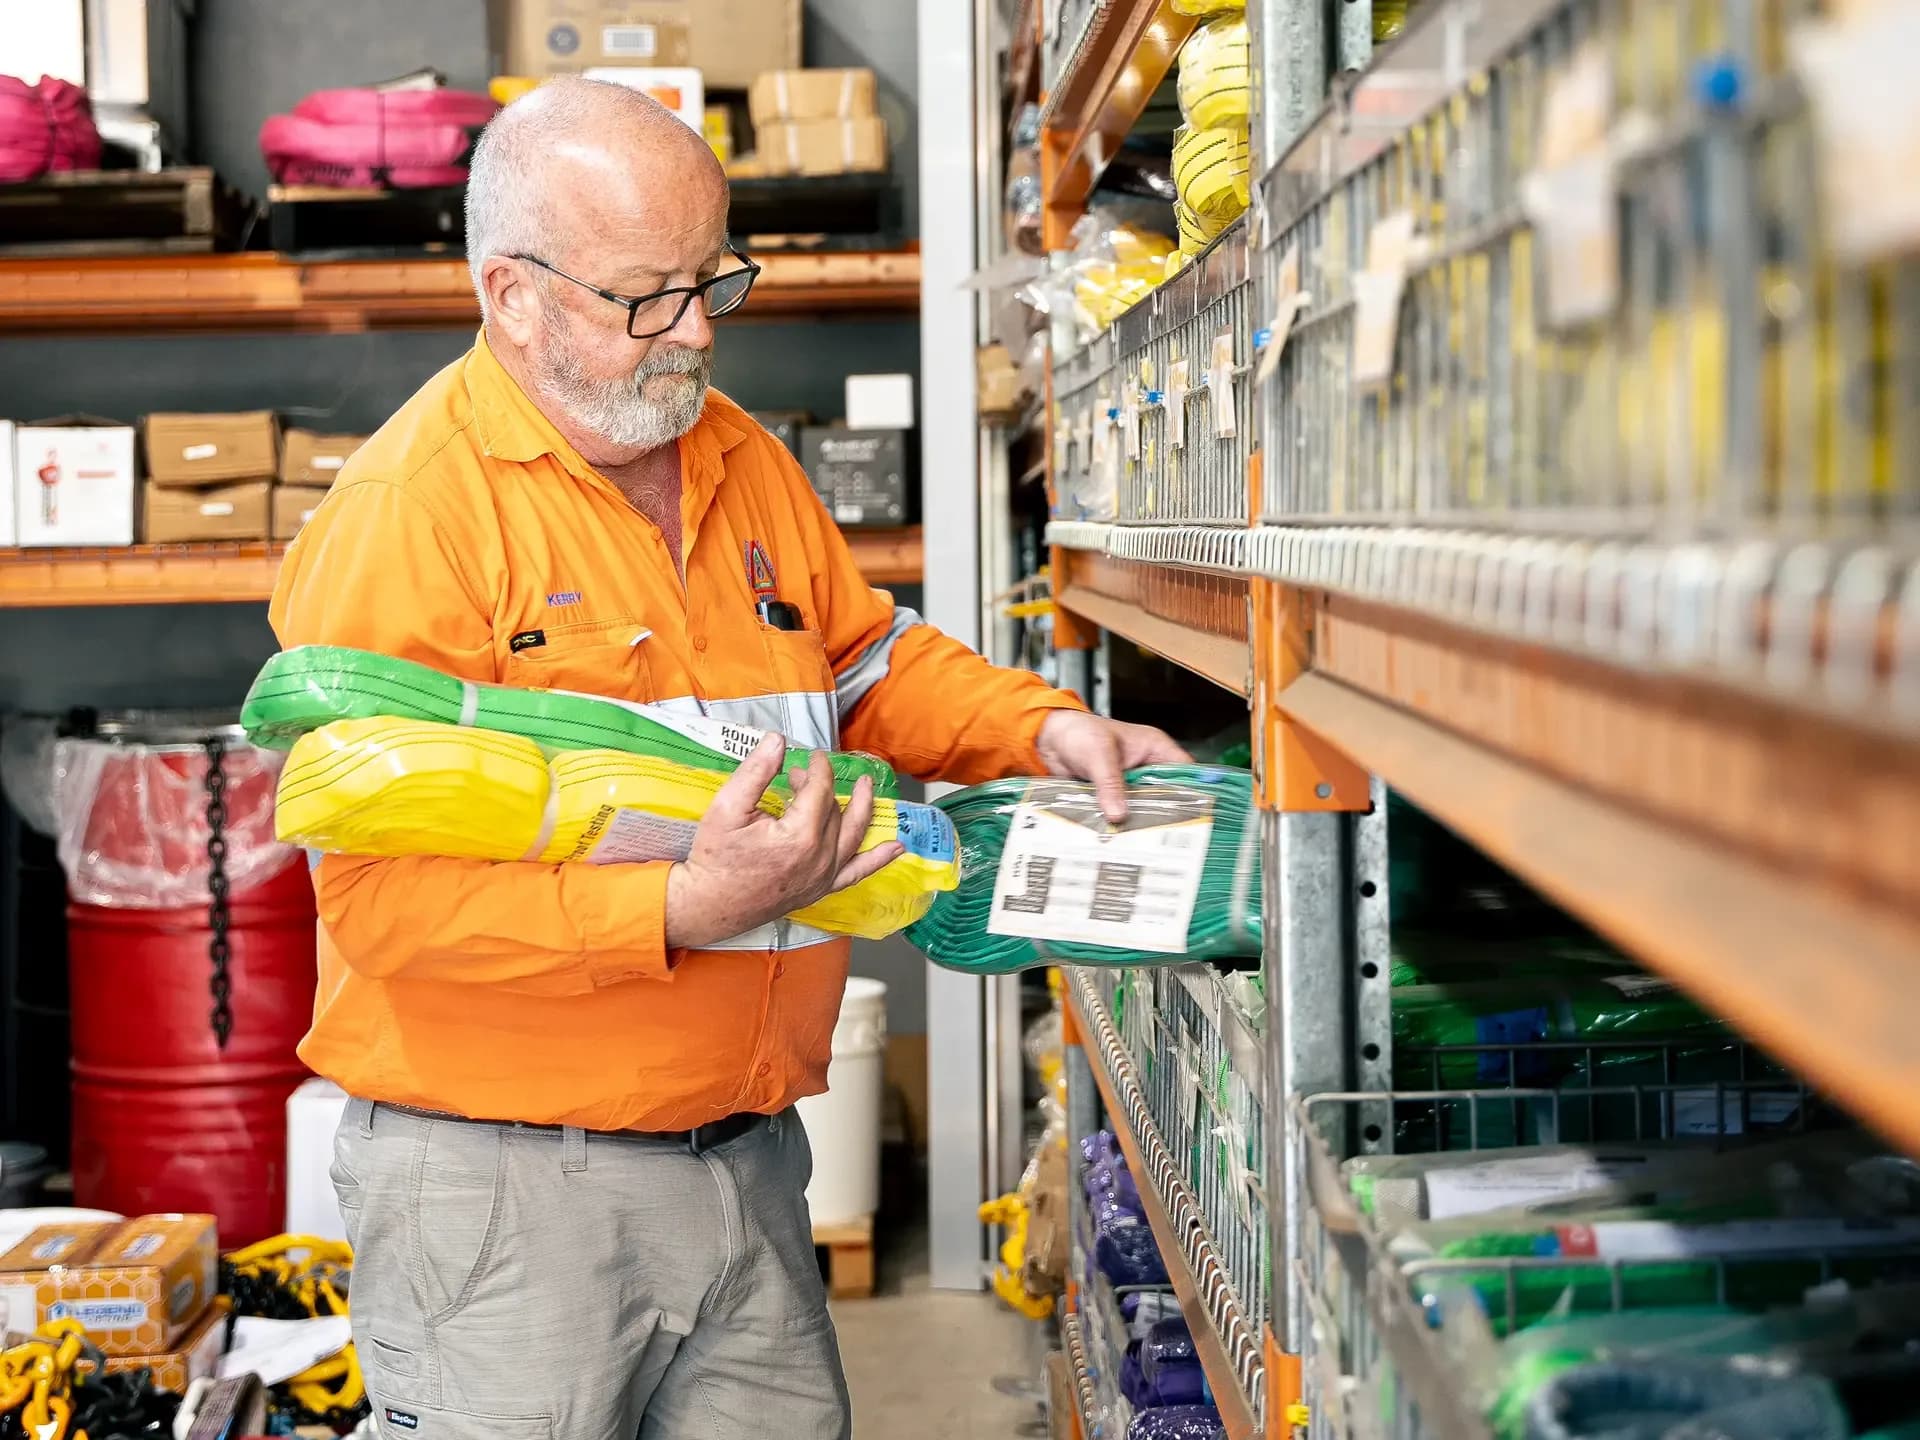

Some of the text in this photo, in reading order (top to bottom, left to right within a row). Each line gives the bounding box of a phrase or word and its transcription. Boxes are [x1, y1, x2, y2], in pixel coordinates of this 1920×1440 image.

[546, 591, 582, 607] KERRY
[721, 725, 760, 747] ROUN
[580, 803, 617, 840] Testing
